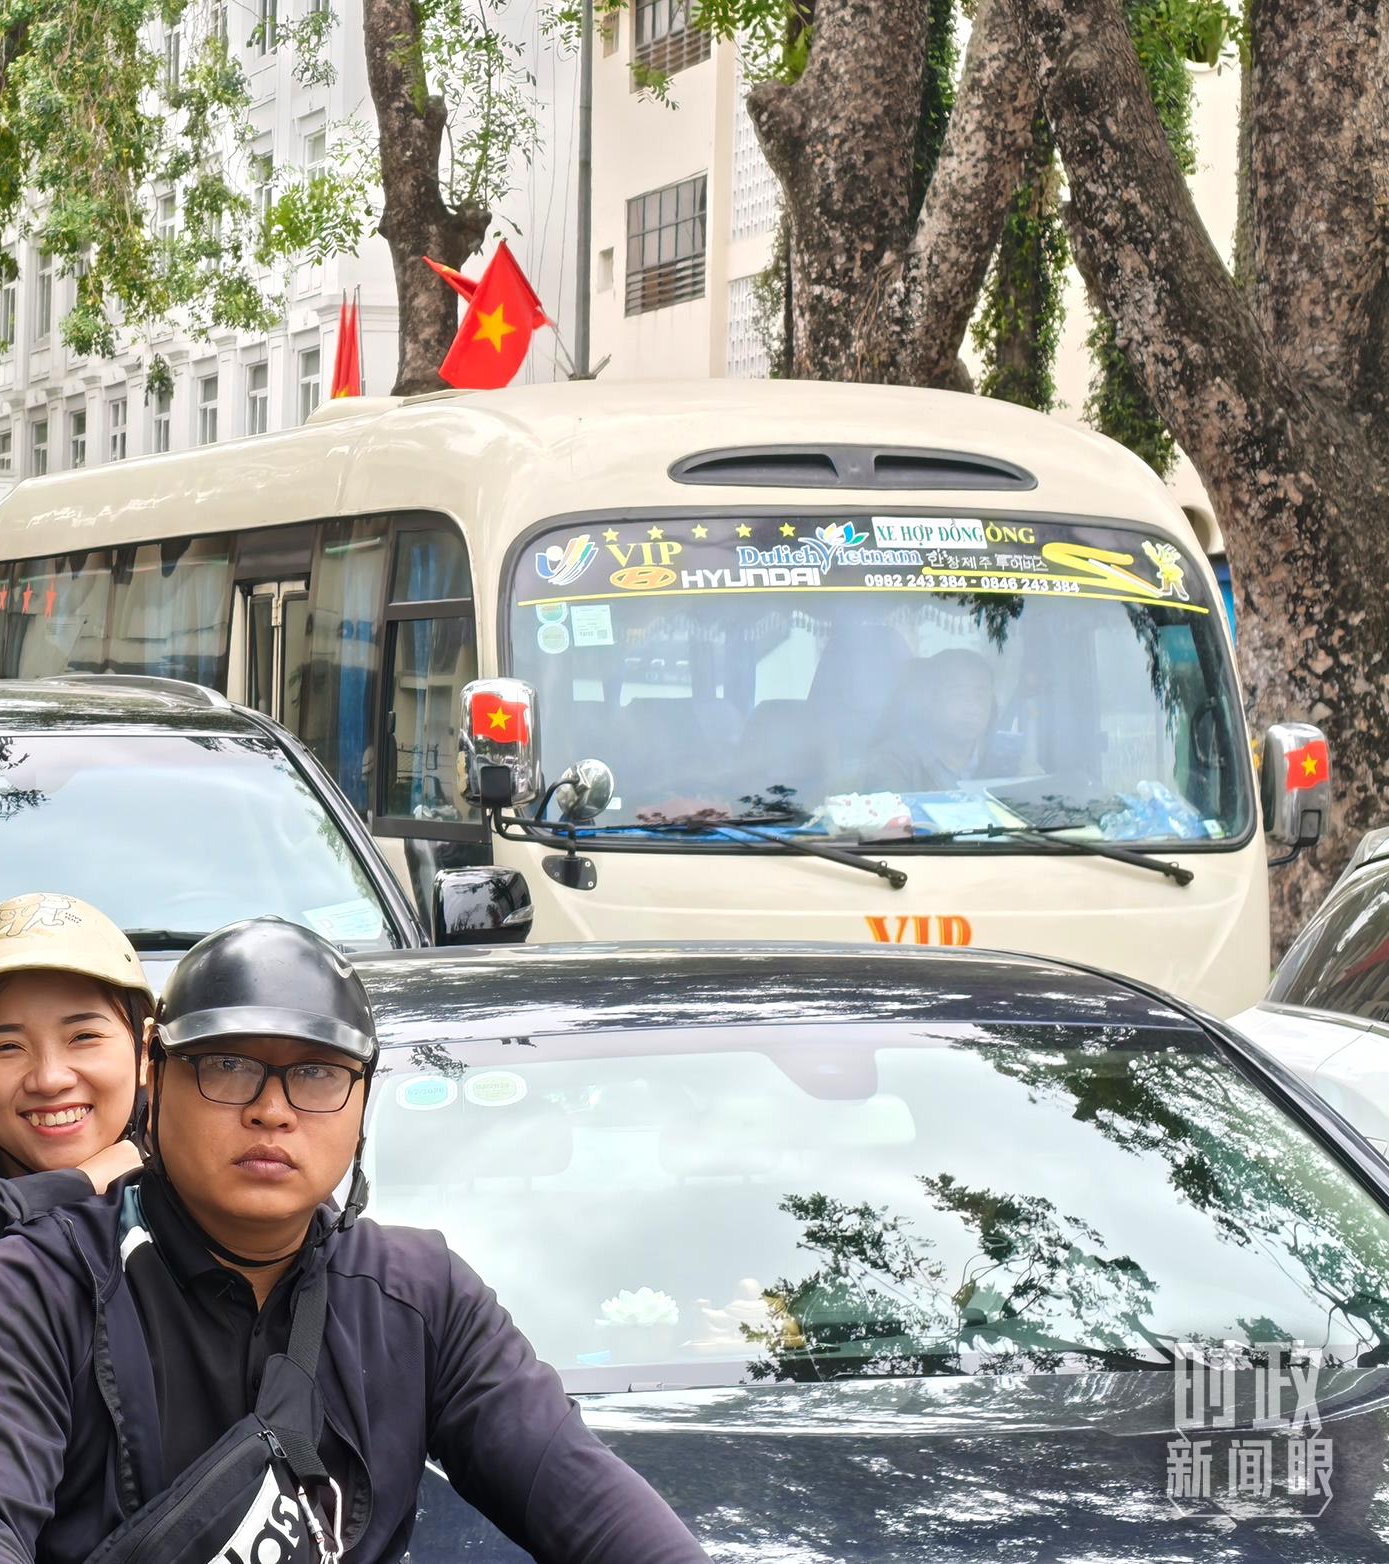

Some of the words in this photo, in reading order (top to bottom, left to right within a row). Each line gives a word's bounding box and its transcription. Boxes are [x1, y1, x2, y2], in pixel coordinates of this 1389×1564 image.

[876, 525, 897, 541] XE
[606, 541, 683, 567] VIP
[681, 568, 820, 588] HYUNDAI
[864, 574, 903, 587] 0982
[906, 574, 935, 587] 243
[939, 575, 967, 588] 384
[980, 576, 1018, 589] 0846
[1021, 578, 1048, 592] 243
[1052, 580, 1080, 593] 384
